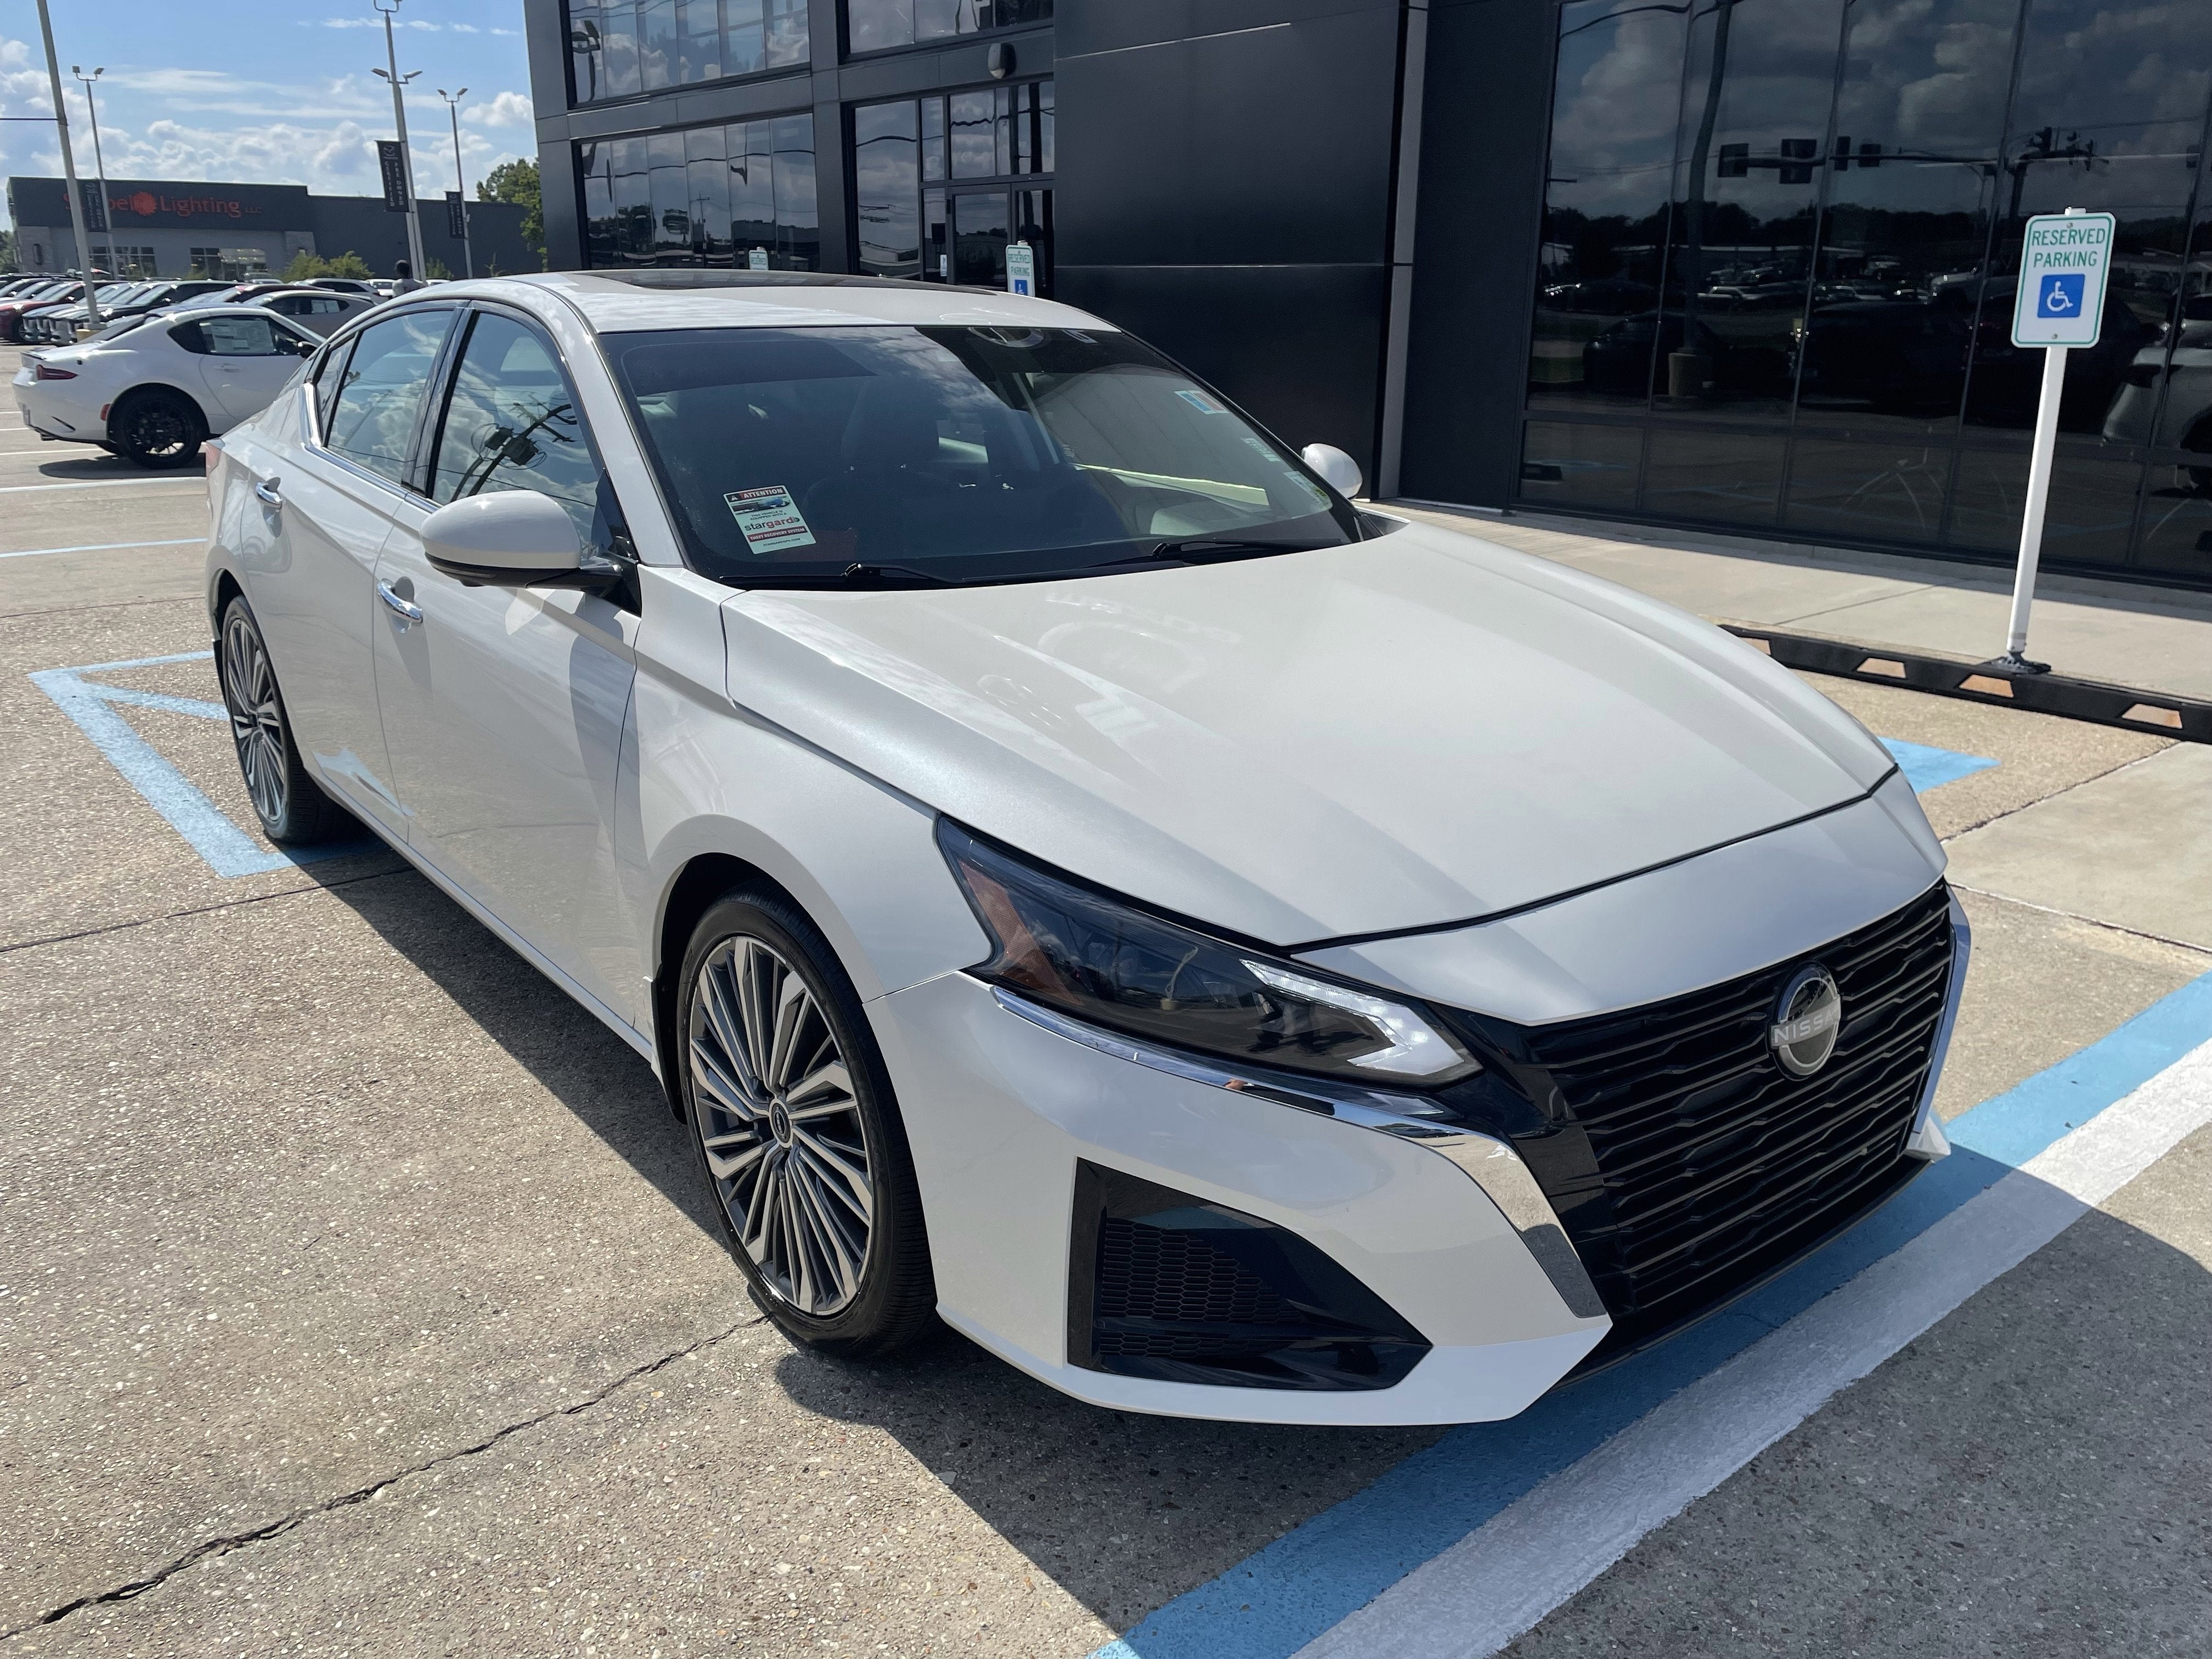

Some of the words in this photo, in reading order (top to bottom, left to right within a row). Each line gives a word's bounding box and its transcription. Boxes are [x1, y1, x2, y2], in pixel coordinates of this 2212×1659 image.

[160, 195, 241, 217] Lighting
[2032, 228, 2106, 246] RESERVED
[2034, 251, 2098, 268] PARKING
[1011, 267, 1030, 276] PARKING
[744, 488, 783, 499] ATTENTION
[744, 517, 793, 531] stargard
